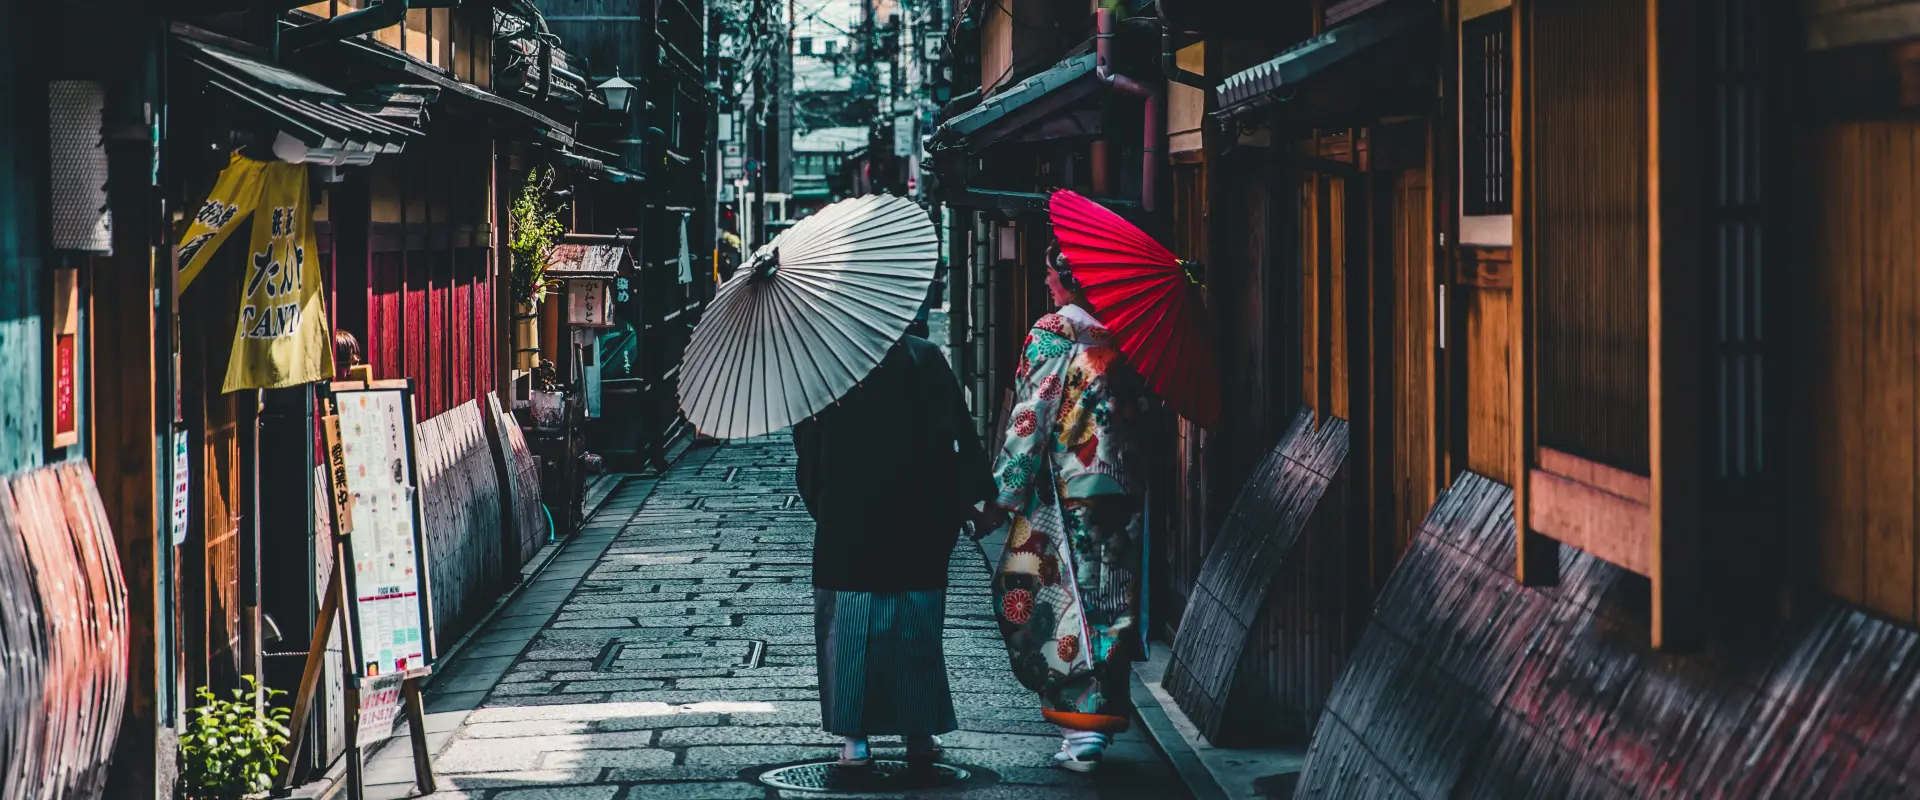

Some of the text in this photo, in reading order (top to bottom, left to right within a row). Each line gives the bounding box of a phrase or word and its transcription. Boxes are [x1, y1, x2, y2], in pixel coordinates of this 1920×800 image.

[388, 403, 397, 451] おしながき
[378, 587, 389, 595] FOOD
